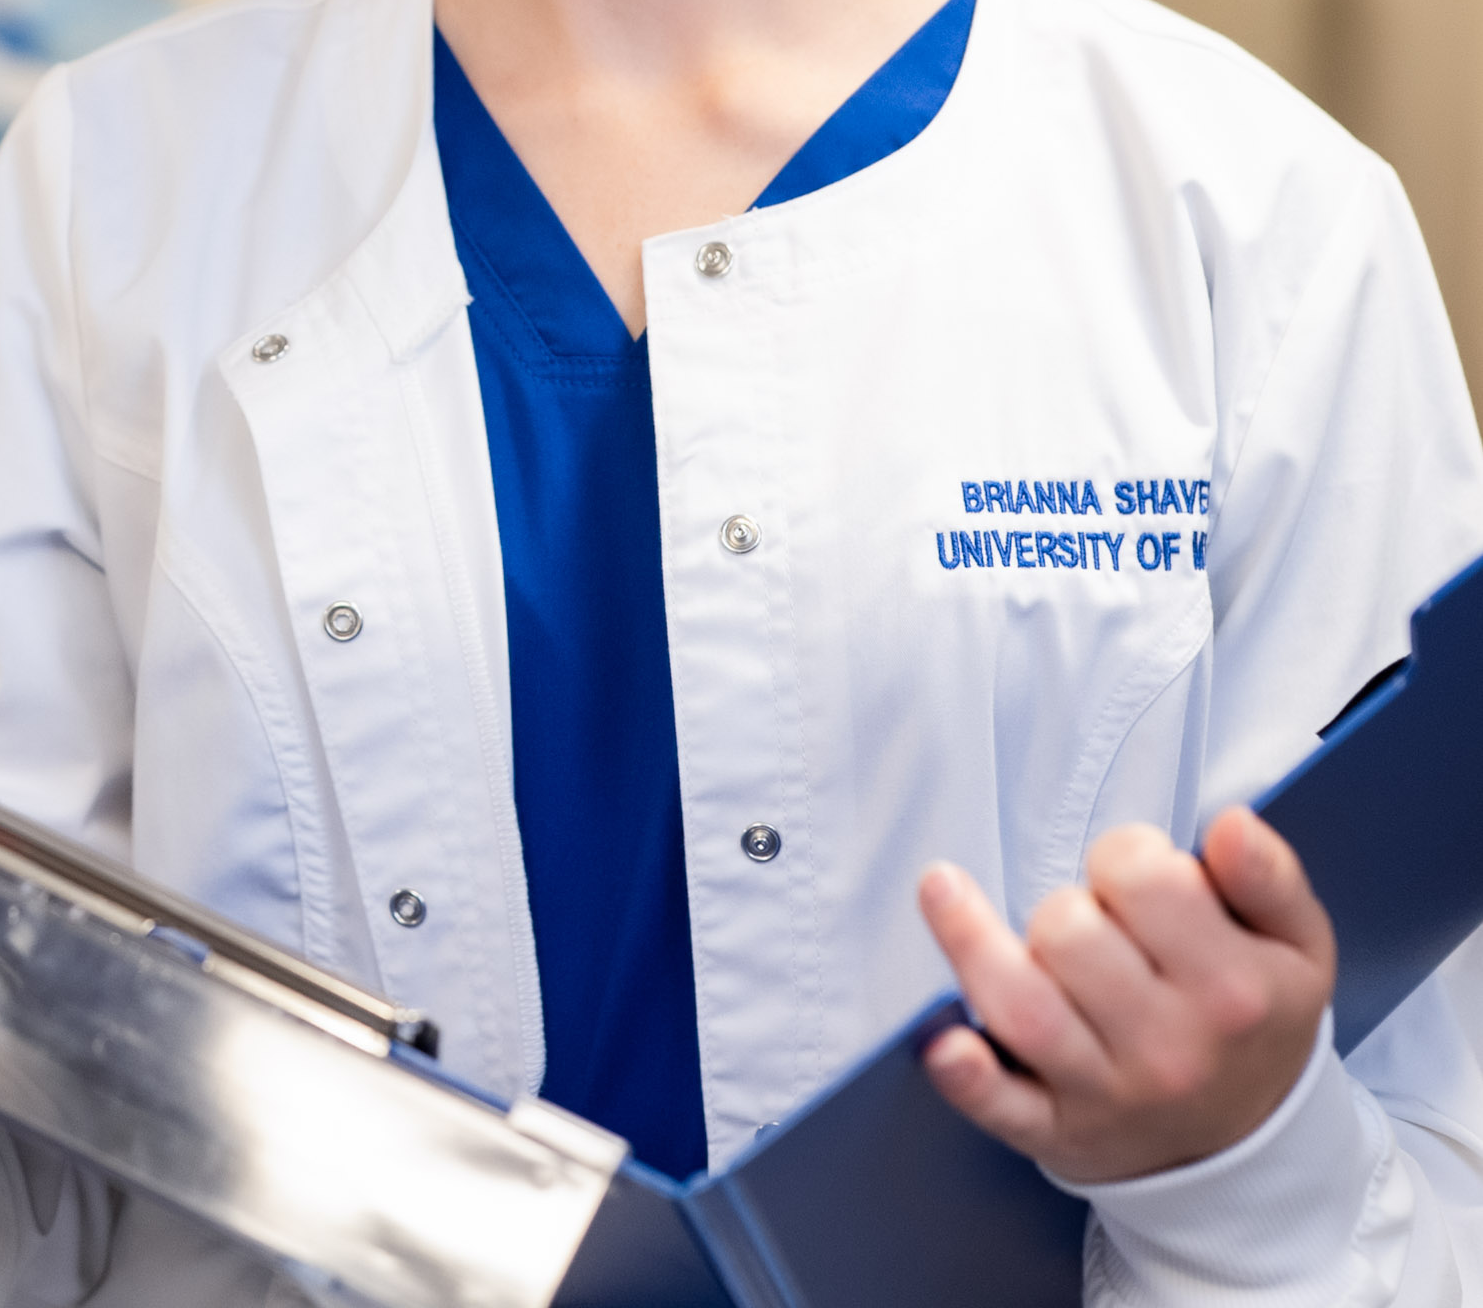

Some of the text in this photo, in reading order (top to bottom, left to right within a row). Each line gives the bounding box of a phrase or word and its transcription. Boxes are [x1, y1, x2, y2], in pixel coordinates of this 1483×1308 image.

[961, 479, 1102, 515] BRIANNA
[936, 529, 1125, 571] UNIVERSITY
[1135, 531, 1182, 571] OF
